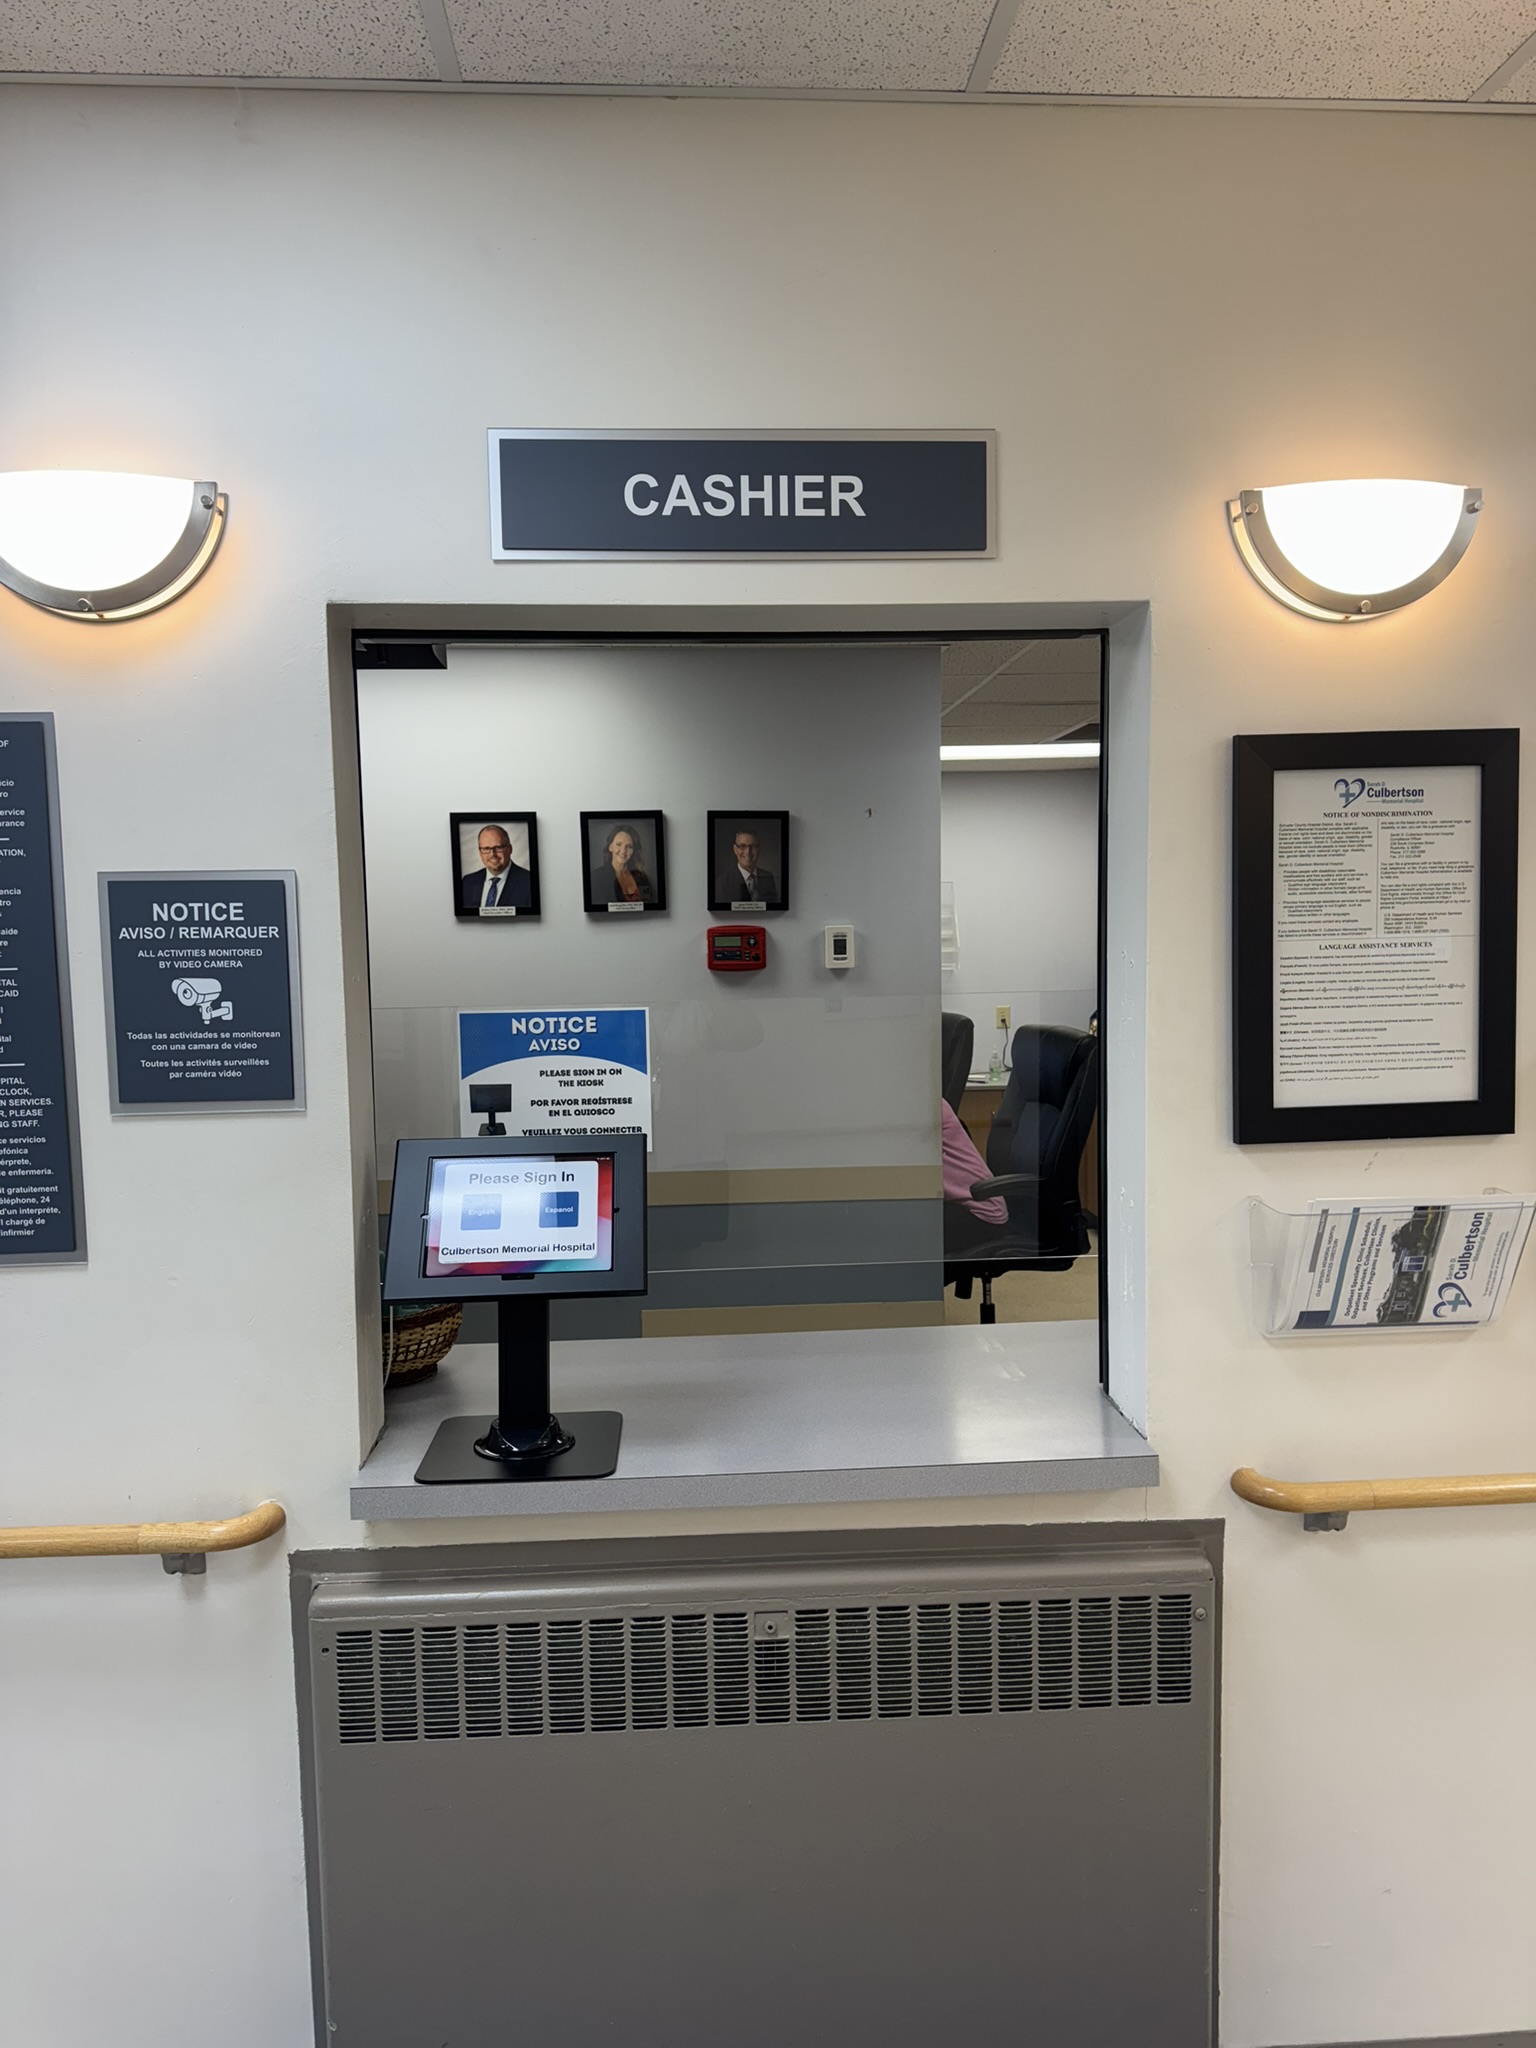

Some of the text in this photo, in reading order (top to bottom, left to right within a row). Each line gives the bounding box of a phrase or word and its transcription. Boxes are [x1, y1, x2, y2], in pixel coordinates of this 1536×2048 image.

[623, 473, 866, 517] CASHIER
[1366, 787, 1424, 798] Culbertson
[1361, 810, 1434, 818] NONDISCRIMINATION
[152, 902, 245, 922] NOTICE
[118, 926, 280, 940] AVISO / REMARQUER
[1358, 942, 1398, 950] ASSISTANCE
[1400, 941, 1433, 949] SERVICES
[137, 948, 263, 958] ALL ACTIVITIES MONITORED
[158, 960, 244, 968] BY VIDEO CAMERA
[511, 1016, 598, 1035] NOTICE
[126, 1032, 153, 1040] Todas
[154, 1031, 168, 1040] las
[169, 1031, 219, 1039] actividades
[232, 1030, 281, 1038] monitorean
[187, 1042, 220, 1050] camara
[220, 1041, 232, 1050] de
[234, 1041, 258, 1050] video
[528, 1038, 581, 1052] AVISO
[140, 1058, 270, 1068] Toutes les activités surveillées
[169, 1069, 243, 1080] par caméra vidéo
[539, 1068, 622, 1078] PLEASE SIGN IN ON
[0, 1077, 26, 1085] PITAL
[558, 1079, 604, 1088] THE KIOSK
[0, 1088, 33, 1096] CLOCK,
[9, 1098, 54, 1107] SERVICES.
[530, 1096, 633, 1108] POR FAVOR REGÍSTRESE
[9, 1109, 44, 1118] PLEASE
[548, 1108, 616, 1118] EN EL QUIOSCO
[11, 1120, 41, 1128] STAFF.
[522, 1128, 562, 1136] VEUILLEZ
[590, 1126, 643, 1134] CONNECTER
[9, 1136, 47, 1144] servicios
[469, 1170, 575, 1186] Please Sign In
[6, 1184, 59, 1196] gratuitement
[40, 1195, 51, 1204] 24
[468, 1206, 574, 1216] English Espanol
[5, 1216, 34, 1228] chargé
[35, 1217, 46, 1225] de
[0, 1228, 36, 1237] infirmier
[1376, 1224, 1387, 1248] Services
[1472, 1211, 1493, 1262] Memorial Hospital
[441, 1242, 596, 1256] Culbertson Memorial Hospital
[1454, 1212, 1485, 1280] Culbertson
[1344, 1220, 1373, 1317] Outpatient Specialty Clinic Schedule,
[1351, 1216, 1382, 1320] Outpatient Services, Culbertson Clinics,
[1367, 1258, 1378, 1285] Programs
[1446, 1264, 1456, 1281] Sarah
[1364, 1285, 1372, 1301] Other
